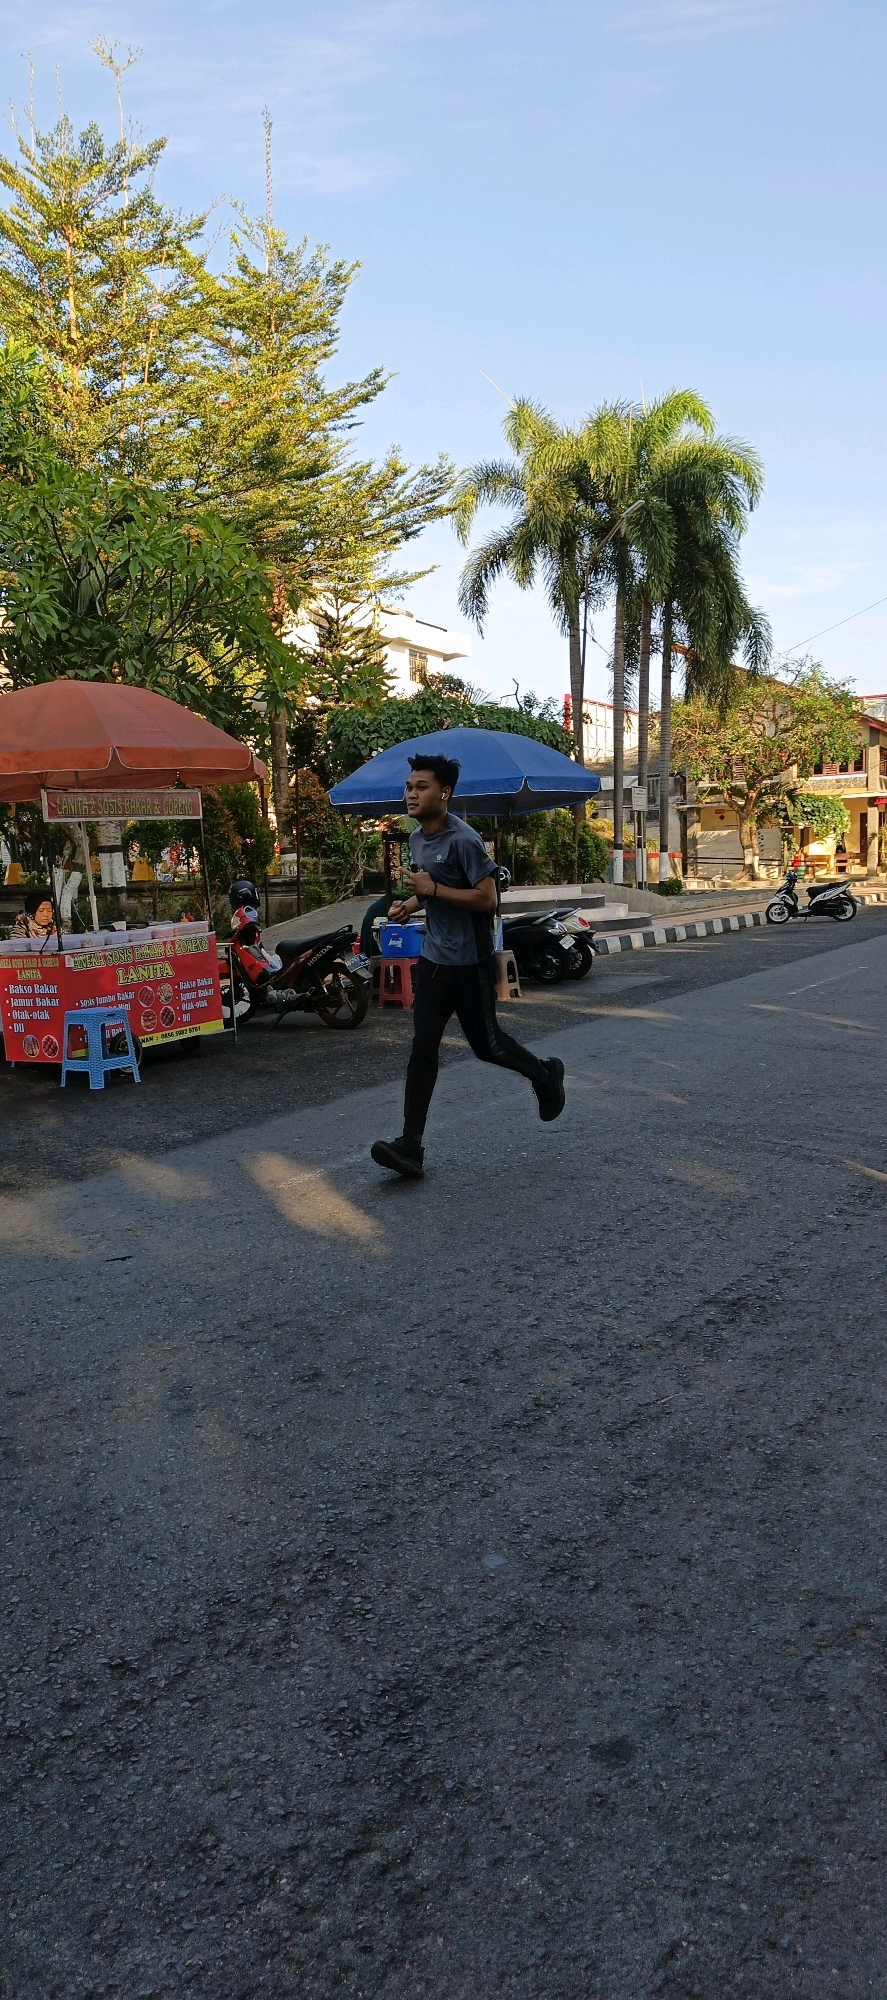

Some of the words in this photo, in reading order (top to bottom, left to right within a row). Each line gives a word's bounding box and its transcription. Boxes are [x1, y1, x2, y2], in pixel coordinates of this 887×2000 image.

[57, 797, 89, 815] LANITA
[97, 797, 123, 815] SOSIS
[124, 797, 152, 815] BAKAR
[154, 799, 160, 815] &
[163, 797, 193, 815] GORENG
[73, 952, 106, 971] ANEKA
[107, 947, 133, 965] SOSIS
[135, 943, 165, 961] BAKAR
[166, 940, 174, 956] &
[175, 936, 208, 955] GORENG
[307, 945, 333, 967] HONDA
[17, 969, 42, 980] LANITA
[117, 961, 175, 985] LANITA
[9, 984, 32, 994] Bakso
[34, 983, 58, 994] Bakar
[179, 980, 196, 990] Bakso
[197, 977, 213, 987] Bakar
[80, 997, 95, 1008] Sosis
[96, 994, 116, 1006] Jumbo
[117, 991, 135, 1001] Bakar
[197, 988, 214, 998] Bakar
[10, 997, 34, 1008] Jamur
[36, 997, 60, 1007] Bakar
[12, 1009, 50, 1020] Otak-otak
